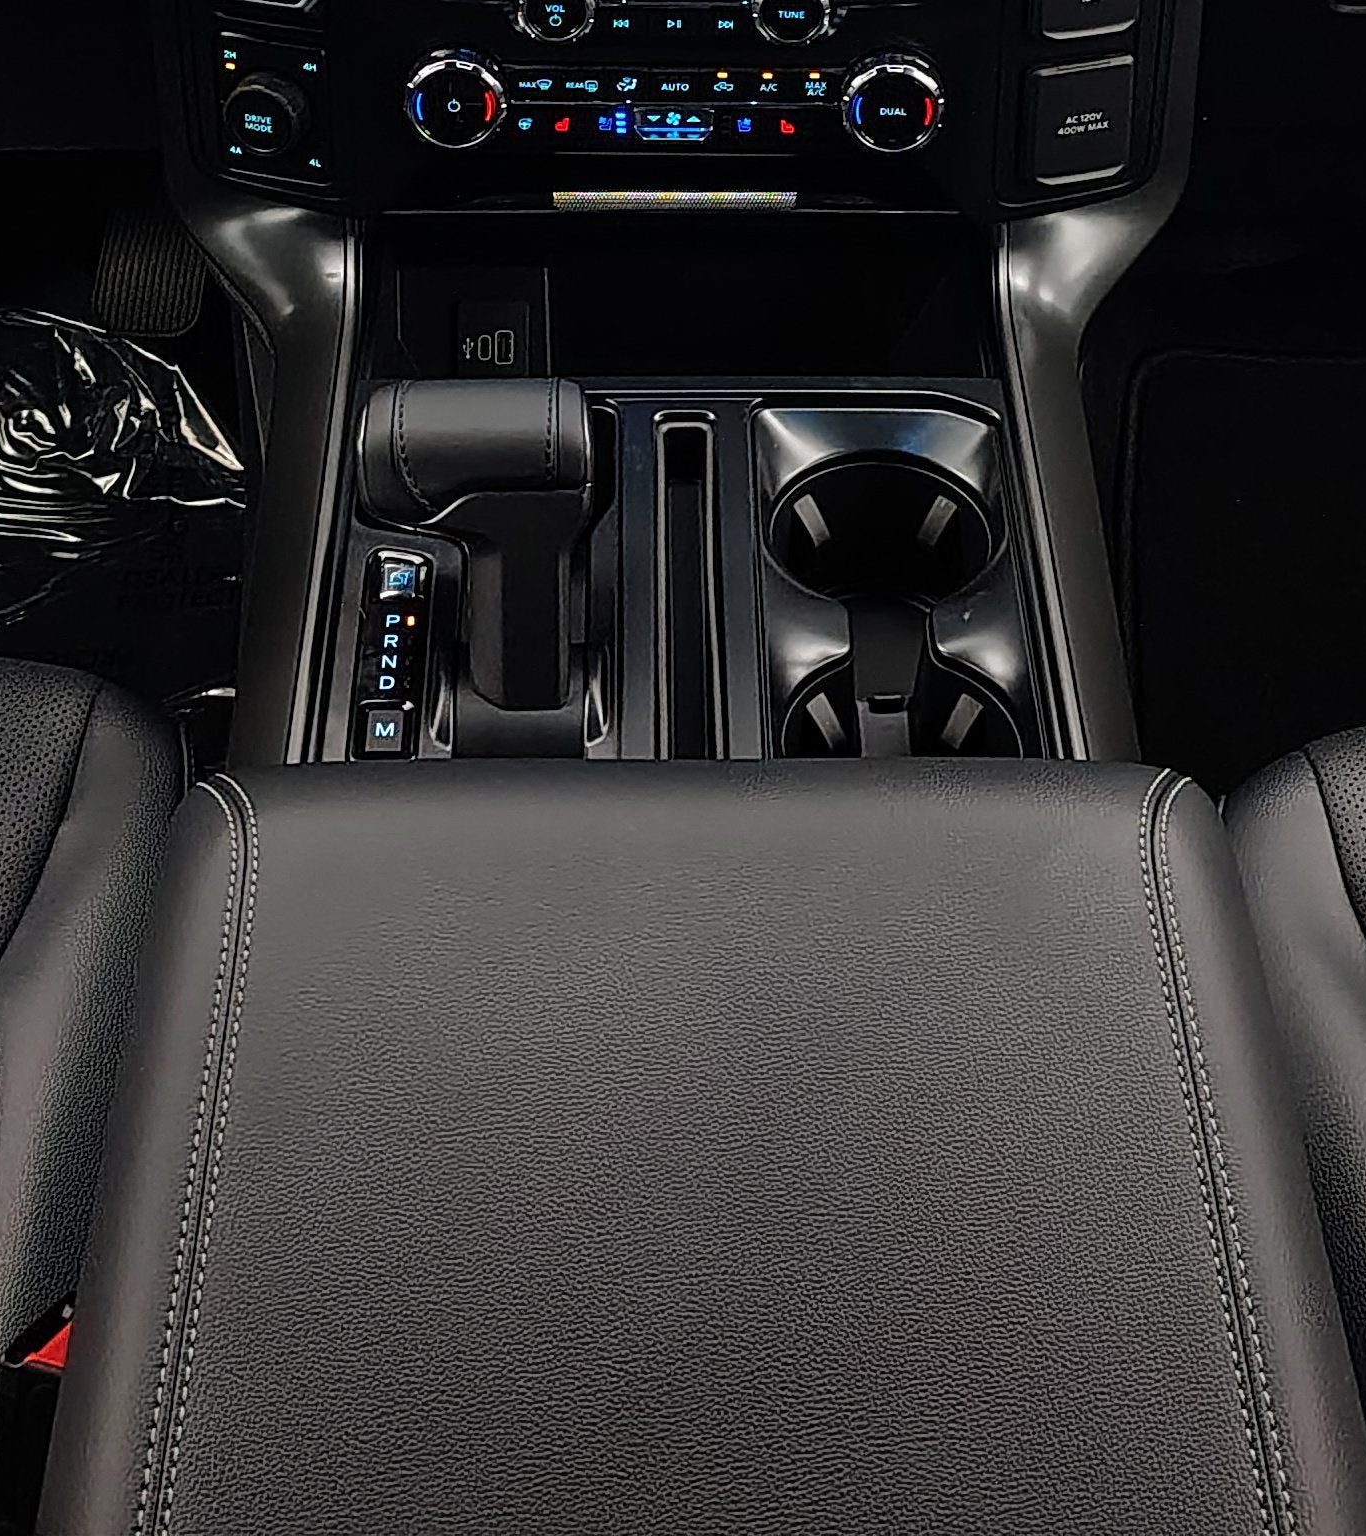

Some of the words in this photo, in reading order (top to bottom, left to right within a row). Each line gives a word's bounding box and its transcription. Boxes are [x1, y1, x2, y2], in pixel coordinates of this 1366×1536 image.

[545, 4, 566, 13] VOL
[778, 10, 806, 19] TUNE
[223, 50, 237, 60] 2H
[303, 62, 317, 72] 4H
[661, 83, 690, 92] AUTO
[760, 83, 778, 92] A/C
[805, 82, 827, 90] MAX
[807, 88, 826, 97] A/C
[879, 108, 907, 116] DUAL
[245, 114, 272, 125] DRIVE
[1065, 115, 1079, 125] AC
[1080, 112, 1103, 123] 120V
[245, 122, 273, 134] MODE
[1057, 124, 1086, 136] 400W
[1087, 120, 1109, 132] MAX
[229, 145, 243, 155] 4A
[309, 158, 322, 168] 4L
[385, 615, 401, 628] P
[383, 634, 398, 648] R
[381, 654, 397, 669] N
[379, 676, 396, 690] D
[375, 722, 395, 737] M
